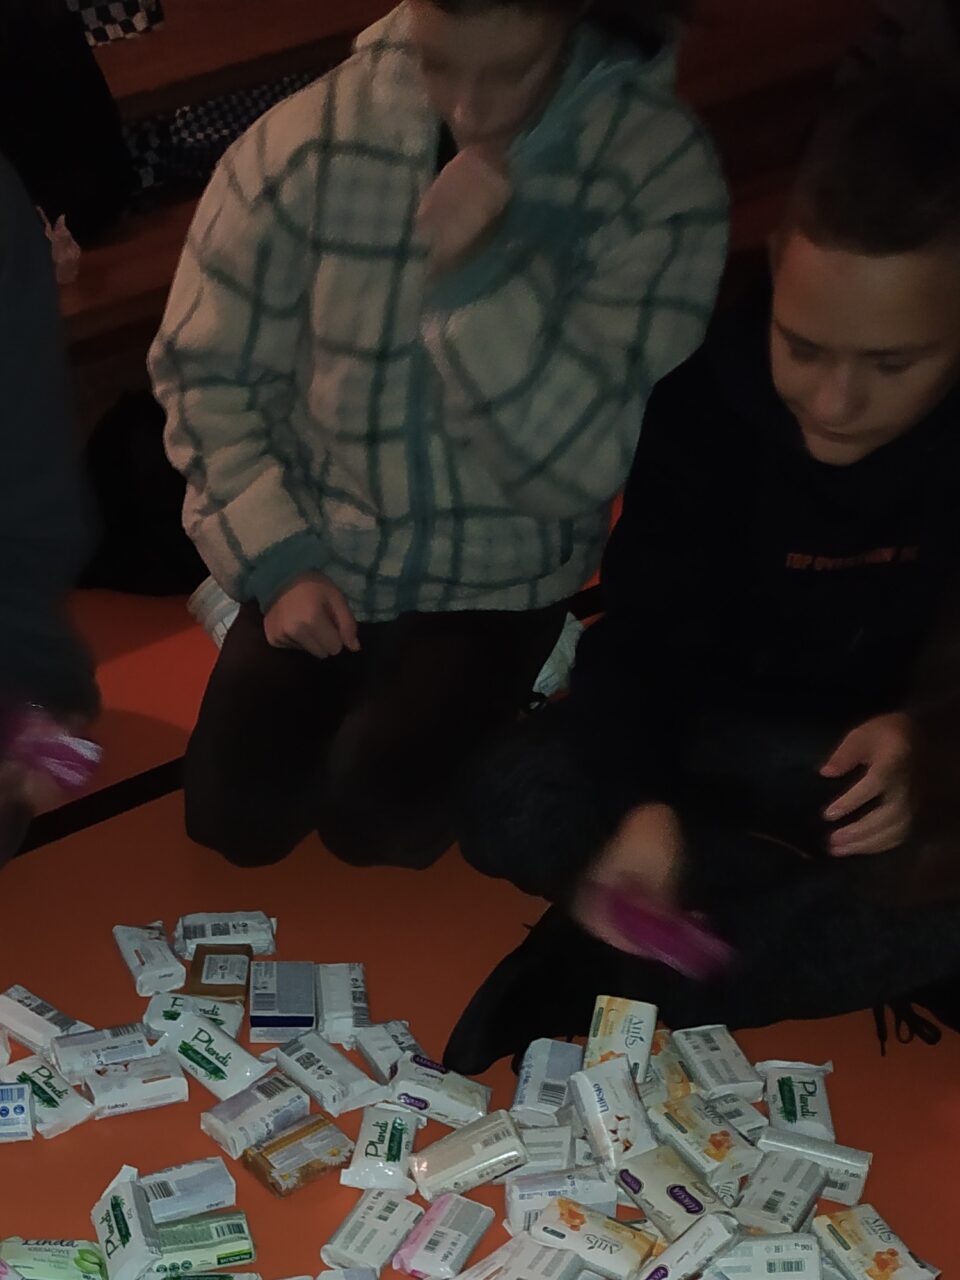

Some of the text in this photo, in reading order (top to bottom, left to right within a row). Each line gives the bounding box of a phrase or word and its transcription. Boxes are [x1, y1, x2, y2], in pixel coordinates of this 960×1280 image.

[192, 1028, 232, 1068] Plendi
[32, 1066, 69, 1099] Plendi
[593, 1083, 610, 1114] Luksja
[798, 1079, 818, 1119] Plendi
[365, 1120, 389, 1158] Plendi
